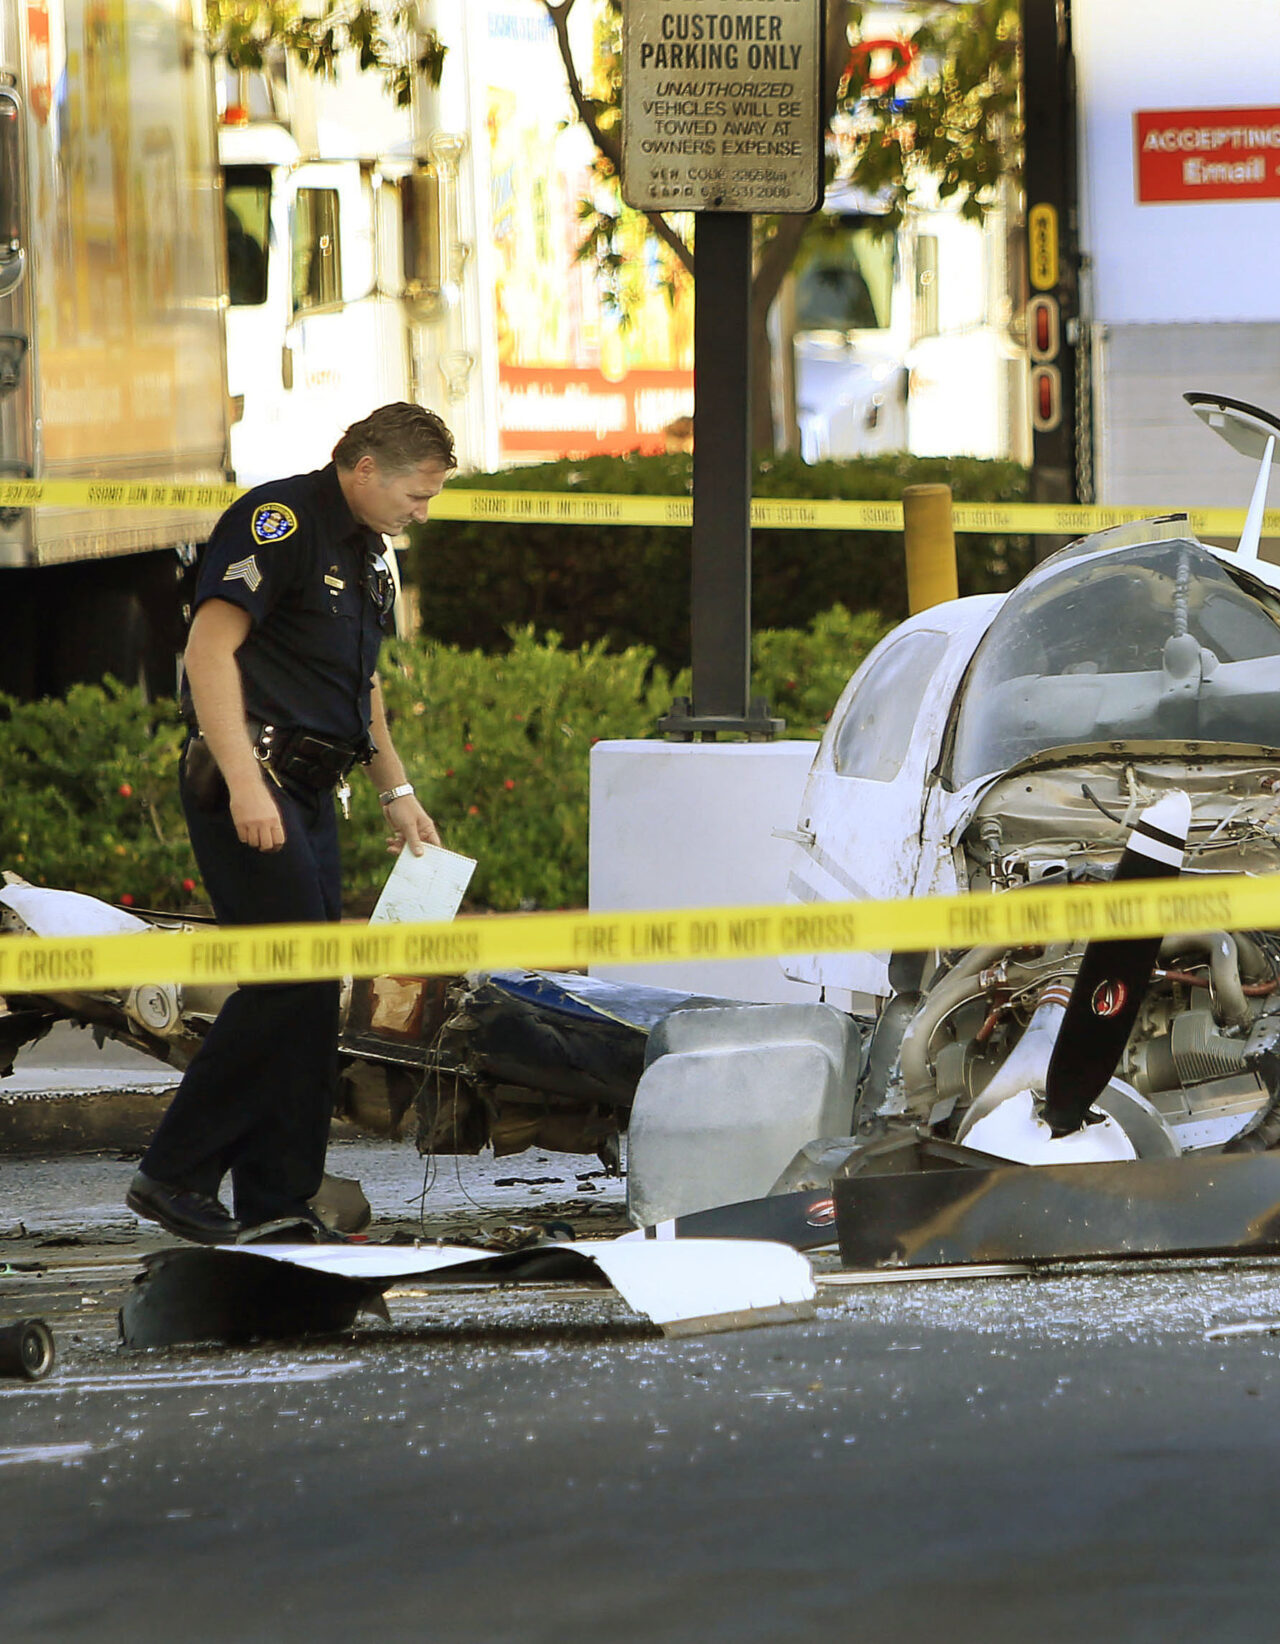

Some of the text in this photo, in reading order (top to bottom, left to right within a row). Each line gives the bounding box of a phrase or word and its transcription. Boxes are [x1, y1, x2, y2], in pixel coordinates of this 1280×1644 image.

[661, 14, 782, 41] CUSTOMER
[640, 43, 803, 70] PARKING ONLY
[655, 81, 794, 98] UNAUTHORIZED
[642, 102, 802, 118] VEHICLES WILL BE
[654, 120, 792, 136] TOWED AWAY AT
[641, 140, 802, 157] OWNERS EXPENSE
[1182, 155, 1266, 185] Email
[948, 890, 1233, 941] FIRE LINE DO NOT CROSS
[572, 912, 857, 960] FIRE LINE DO NOT CROSS
[17, 947, 94, 983] CROSS
[189, 930, 480, 976] FIRE LINE DO NOT CROSS
